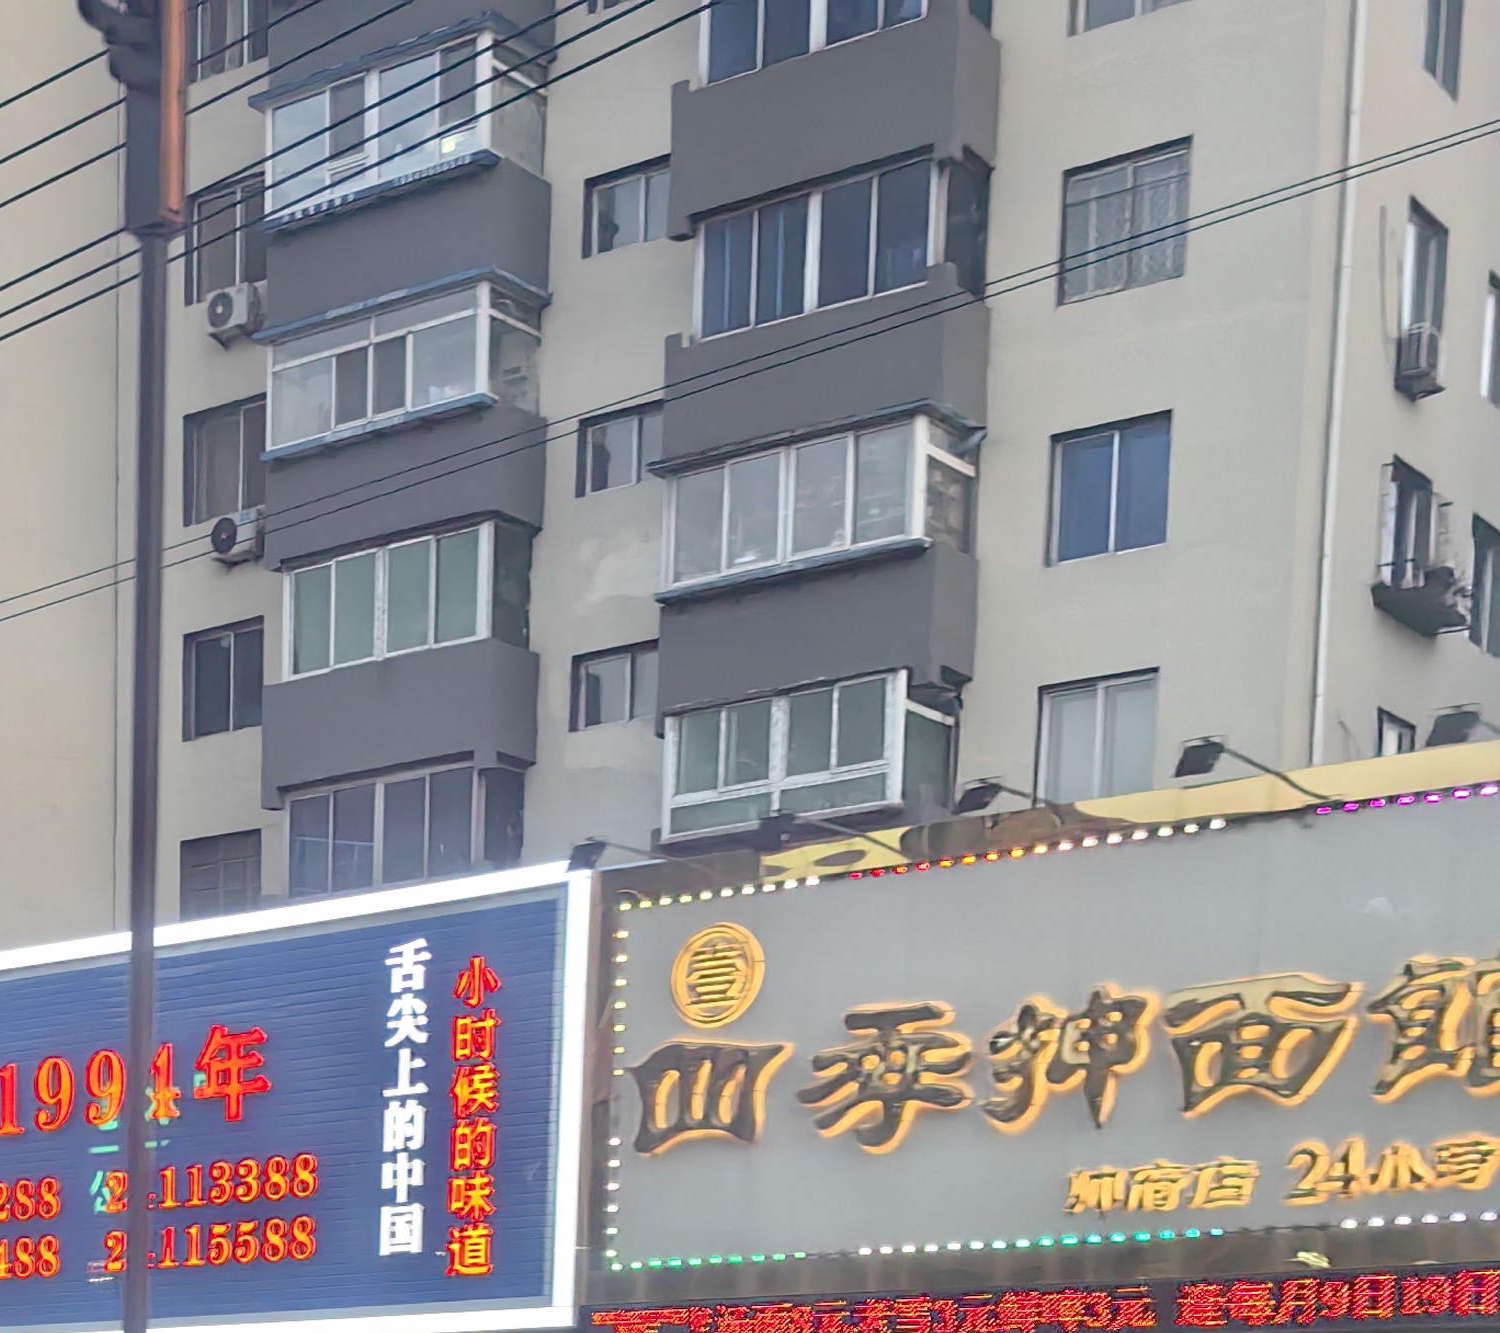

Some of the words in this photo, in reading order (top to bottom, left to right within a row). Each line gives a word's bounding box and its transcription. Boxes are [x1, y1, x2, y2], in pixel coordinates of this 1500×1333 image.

[103, 1153, 318, 1213] 2113388
[379, 938, 432, 1257] 舌尖上的中国
[445, 955, 501, 1278] 小时候的味道
[103, 1215, 317, 1273] 2115588
